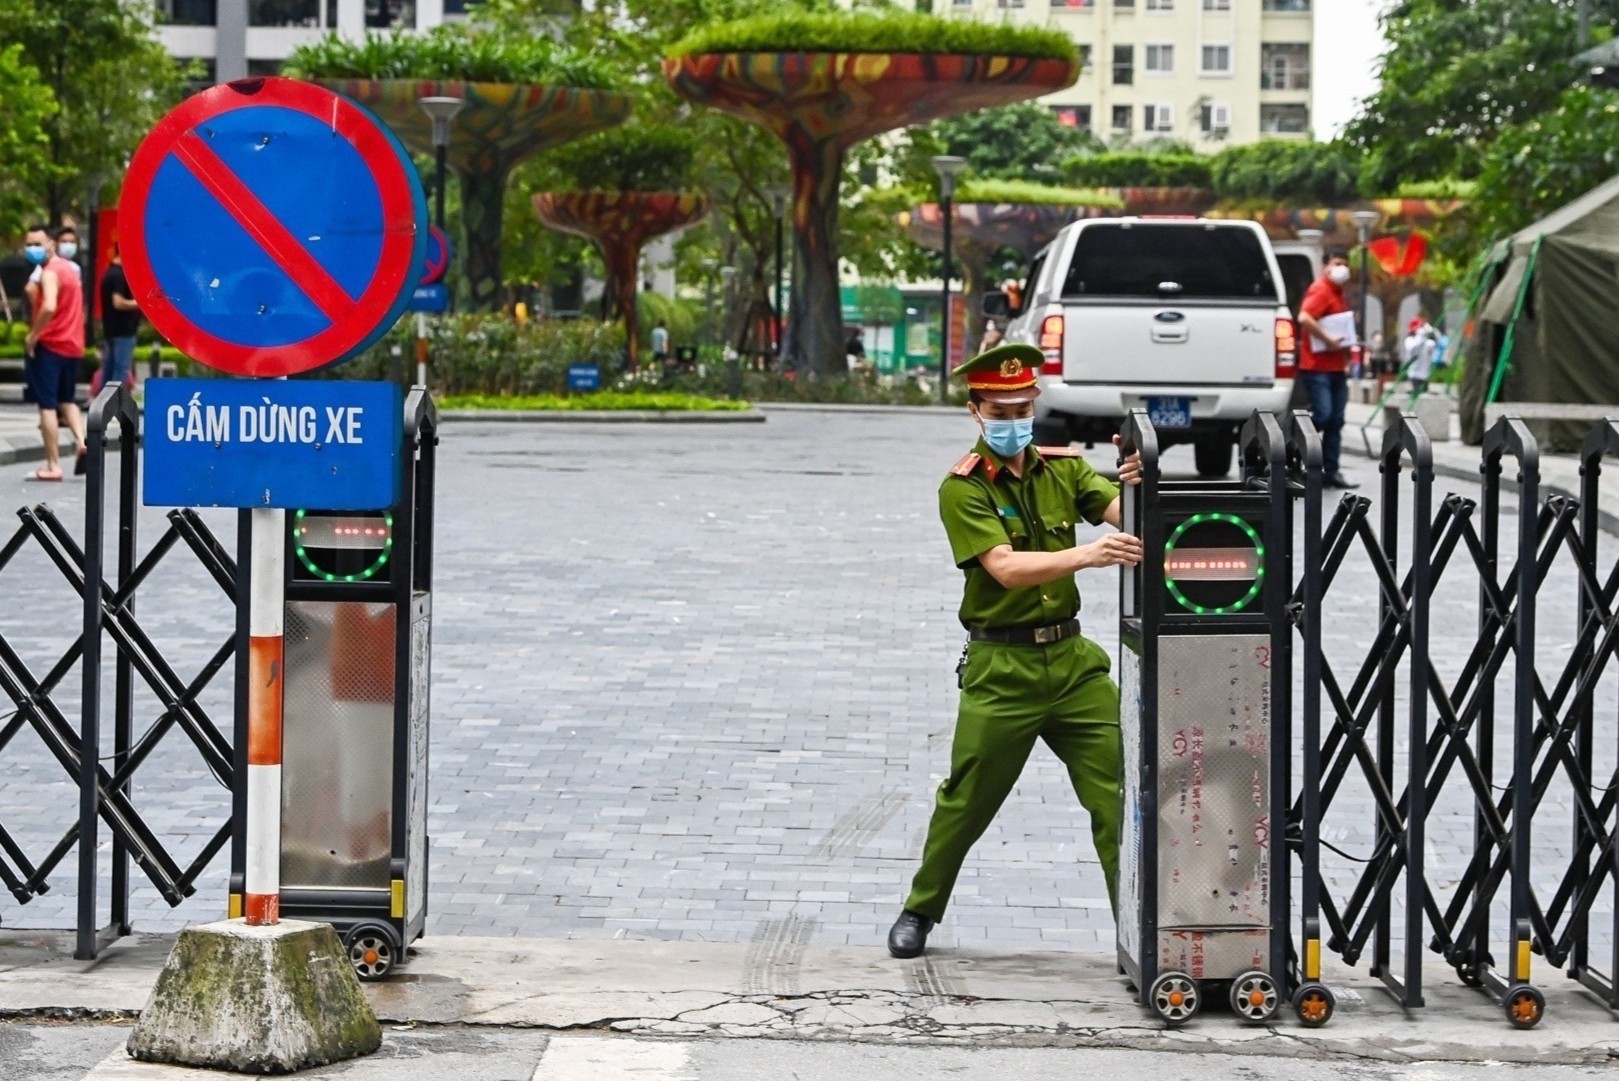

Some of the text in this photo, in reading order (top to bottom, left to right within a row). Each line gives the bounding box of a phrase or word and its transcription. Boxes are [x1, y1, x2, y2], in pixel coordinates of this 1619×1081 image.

[167, 391, 364, 444] CẤM DỪNG XE
[1173, 728, 1188, 758] YCY
[1253, 815, 1269, 849] YCY
